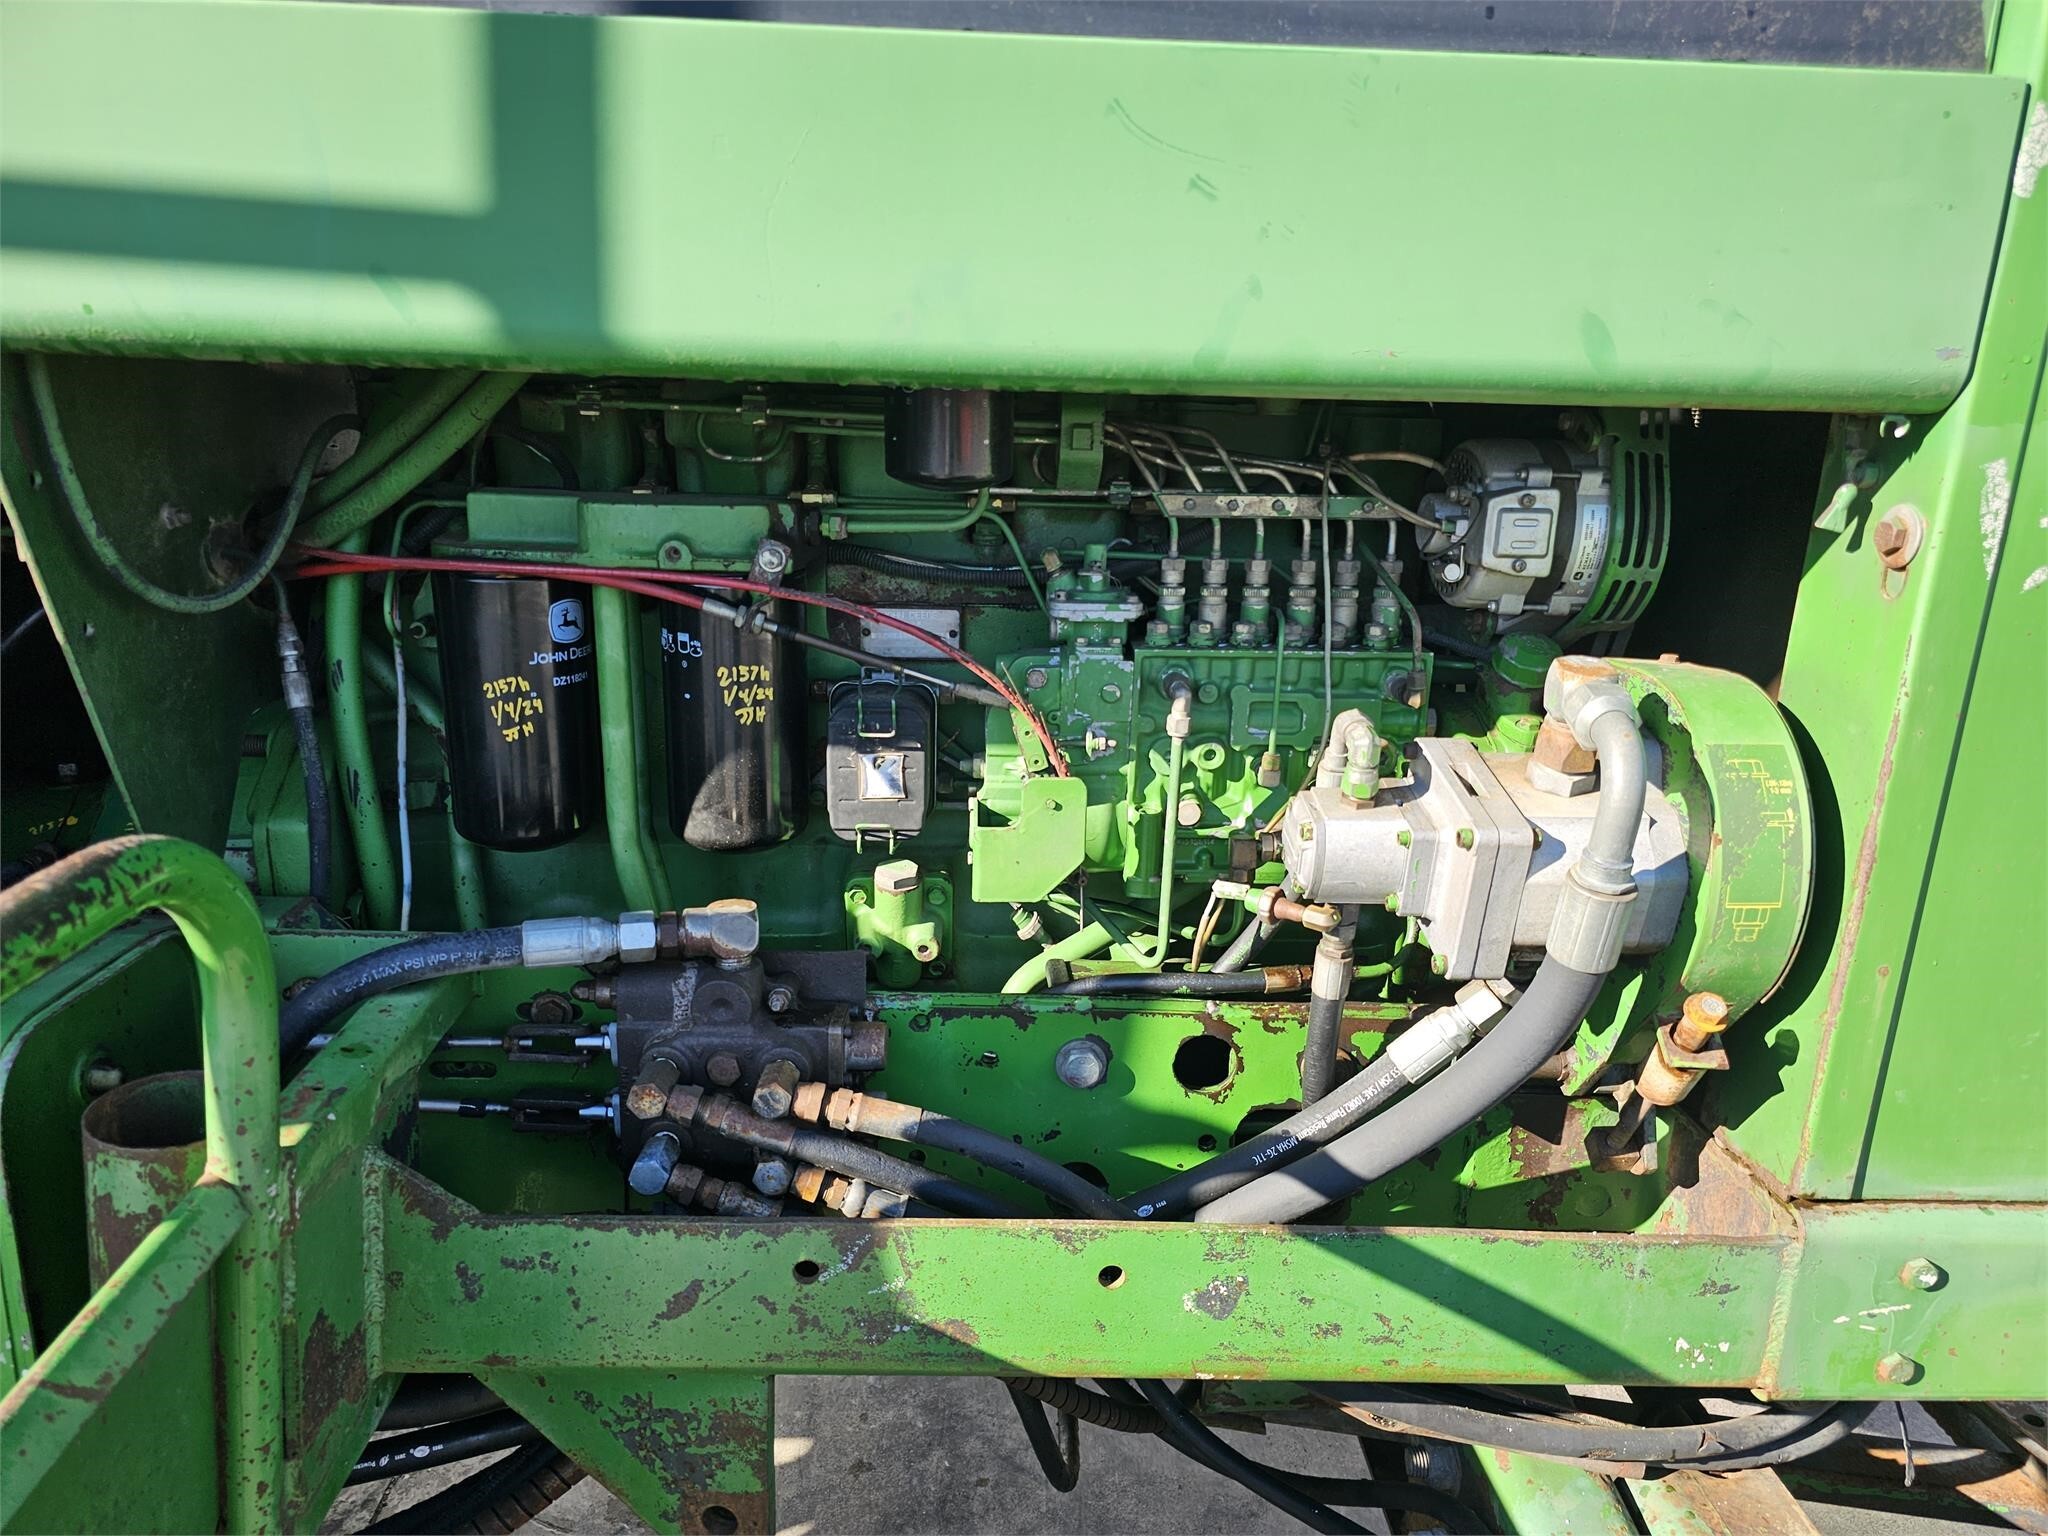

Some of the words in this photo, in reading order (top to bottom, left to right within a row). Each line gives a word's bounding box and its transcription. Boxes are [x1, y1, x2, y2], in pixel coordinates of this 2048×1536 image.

[529, 650, 568, 665] JOHN
[483, 676, 531, 700] 2157h
[723, 683, 774, 707] 1/4/24
[490, 696, 544, 727] 1/4/24
[372, 961, 403, 981] MAX
[404, 956, 426, 971] PSI
[1361, 1084, 1378, 1101] SAE
[1325, 1105, 1347, 1124] Flame
[1295, 1118, 1328, 1142] Resistant
[1276, 1135, 1298, 1153] MSHA
